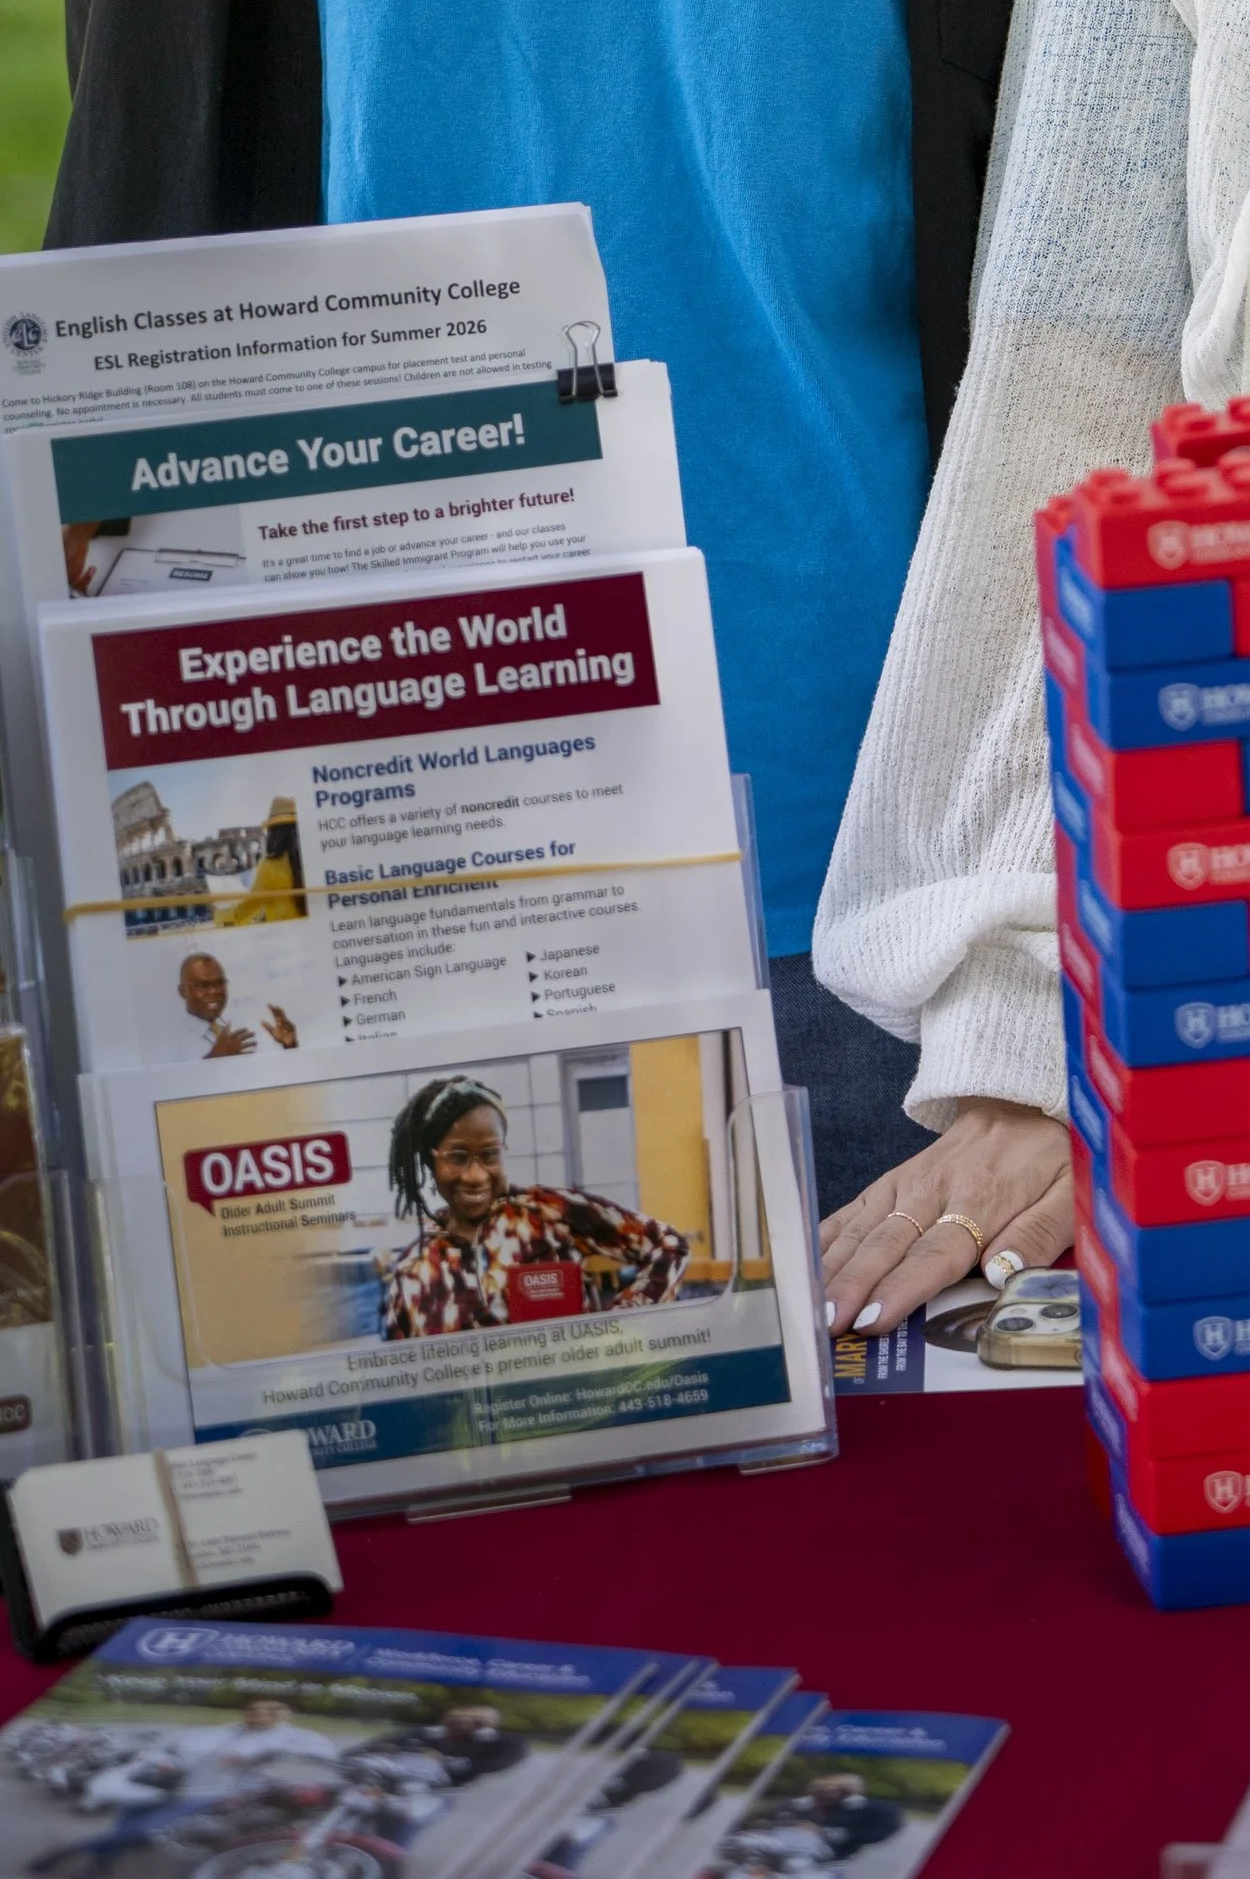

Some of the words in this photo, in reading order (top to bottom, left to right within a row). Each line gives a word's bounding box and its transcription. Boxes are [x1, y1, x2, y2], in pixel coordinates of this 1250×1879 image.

[56, 314, 128, 339] English
[134, 310, 206, 329] Classes
[213, 306, 234, 323] at
[239, 296, 318, 320] Howard
[325, 286, 440, 311] Community
[447, 279, 520, 299] College
[94, 354, 123, 370] ESL
[127, 345, 231, 368] Registration
[236, 334, 337, 356] Information
[341, 331, 365, 346] for
[370, 326, 441, 343] Summer
[446, 319, 486, 336] 2026
[1, 398, 27, 407] Come
[42, 394, 75, 402] Hickory
[78, 391, 102, 400] Ridge
[105, 387, 141, 397] Building
[144, 384, 173, 394] (Room
[176, 380, 195, 390] 108)
[198, 380, 209, 388] on
[211, 378, 226, 386] the
[228, 374, 263, 384] Howard
[265, 370, 316, 381] Community
[317, 366, 349, 376] College
[352, 364, 385, 373] campus
[387, 361, 399, 370] for
[403, 356, 448, 369] placement
[450, 354, 467, 363] test
[469, 352, 486, 362] and
[488, 348, 525, 361] personal
[131, 449, 288, 490] Advance
[296, 436, 382, 469] Your
[393, 413, 524, 458] Career!
[258, 522, 297, 539] Take
[301, 519, 329, 534] the
[332, 514, 368, 530] first
[372, 512, 408, 526] step
[412, 508, 429, 521] to
[435, 507, 444, 518] a
[448, 497, 514, 517] brighter
[518, 487, 574, 507] future!
[264, 573, 281, 582] can
[282, 570, 306, 579] show
[308, 568, 325, 578] you
[327, 563, 349, 574] how!
[351, 561, 368, 570] The
[370, 557, 400, 568] Skilled
[402, 551, 448, 564] Immigrant
[450, 547, 489, 559] Program
[491, 543, 506, 553] will
[508, 541, 527, 551] help
[529, 540, 546, 550] you
[548, 537, 564, 546] use
[566, 535, 585, 546] your
[180, 634, 381, 684] Experience
[391, 621, 450, 656] the
[460, 605, 566, 648] World
[121, 686, 277, 735] Through
[286, 672, 465, 716] Language
[474, 649, 634, 694] Learning
[312, 755, 413, 783] Noncredit
[417, 746, 479, 770] World
[484, 736, 595, 762] Languages
[315, 783, 415, 808] Programs
[318, 817, 344, 830] HCC
[349, 813, 385, 827] offers
[389, 813, 396, 823] a
[400, 808, 441, 821] variety
[444, 803, 456, 815] of
[460, 797, 520, 814] noncredit
[525, 792, 572, 807] courses
[575, 789, 588, 799] to
[592, 784, 623, 796] meet
[321, 837, 346, 851] your
[351, 829, 408, 845] language
[411, 822, 462, 837] learning
[465, 816, 506, 831] needs.
[324, 868, 373, 885] Basic
[379, 857, 466, 879] Language
[471, 846, 545, 866] Courses
[549, 840, 575, 857] for
[328, 885, 407, 909] Personal
[331, 919, 365, 932] Learn
[369, 911, 425, 927] language
[429, 898, 515, 919] fundamentals
[519, 895, 548, 907] from
[552, 888, 607, 906] grammar
[611, 886, 624, 896] to
[333, 930, 413, 949] conversation
[417, 926, 428, 938] in
[431, 924, 466, 937] these
[469, 920, 490, 931] fun
[493, 914, 516, 929] and
[520, 908, 585, 925] interactive
[588, 901, 641, 917] courses.
[335, 949, 404, 967] Languages
[407, 942, 455, 958] include:
[352, 969, 410, 985] American
[414, 964, 441, 978] Sign
[445, 957, 506, 974] Language
[540, 945, 599, 961] Japanese
[544, 966, 587, 980] Korean
[353, 989, 397, 1005] French
[544, 983, 615, 1000] Portuguese
[356, 1010, 405, 1025] German
[202, 1139, 334, 1197] OASIS
[223, 1216, 297, 1236] Instructional
[300, 1210, 356, 1226] Seminars
[483, 1327, 547, 1352] learning
[550, 1325, 566, 1342] at
[263, 1382, 324, 1403] Howard
[327, 1370, 418, 1395] Community
[497, 1353, 555, 1375] premier
[561, 1345, 599, 1362] older
[604, 1338, 643, 1357] adult
[648, 1328, 710, 1351] summit!
[503, 1414, 536, 1431] More
[539, 1405, 614, 1426] Information:
[618, 1388, 709, 1413] 443-518-4659
[529, 1392, 572, 1407] Online:
[576, 1372, 709, 1400] HowardCC.edu/Oasis
[308, 1420, 376, 1445] WARD
